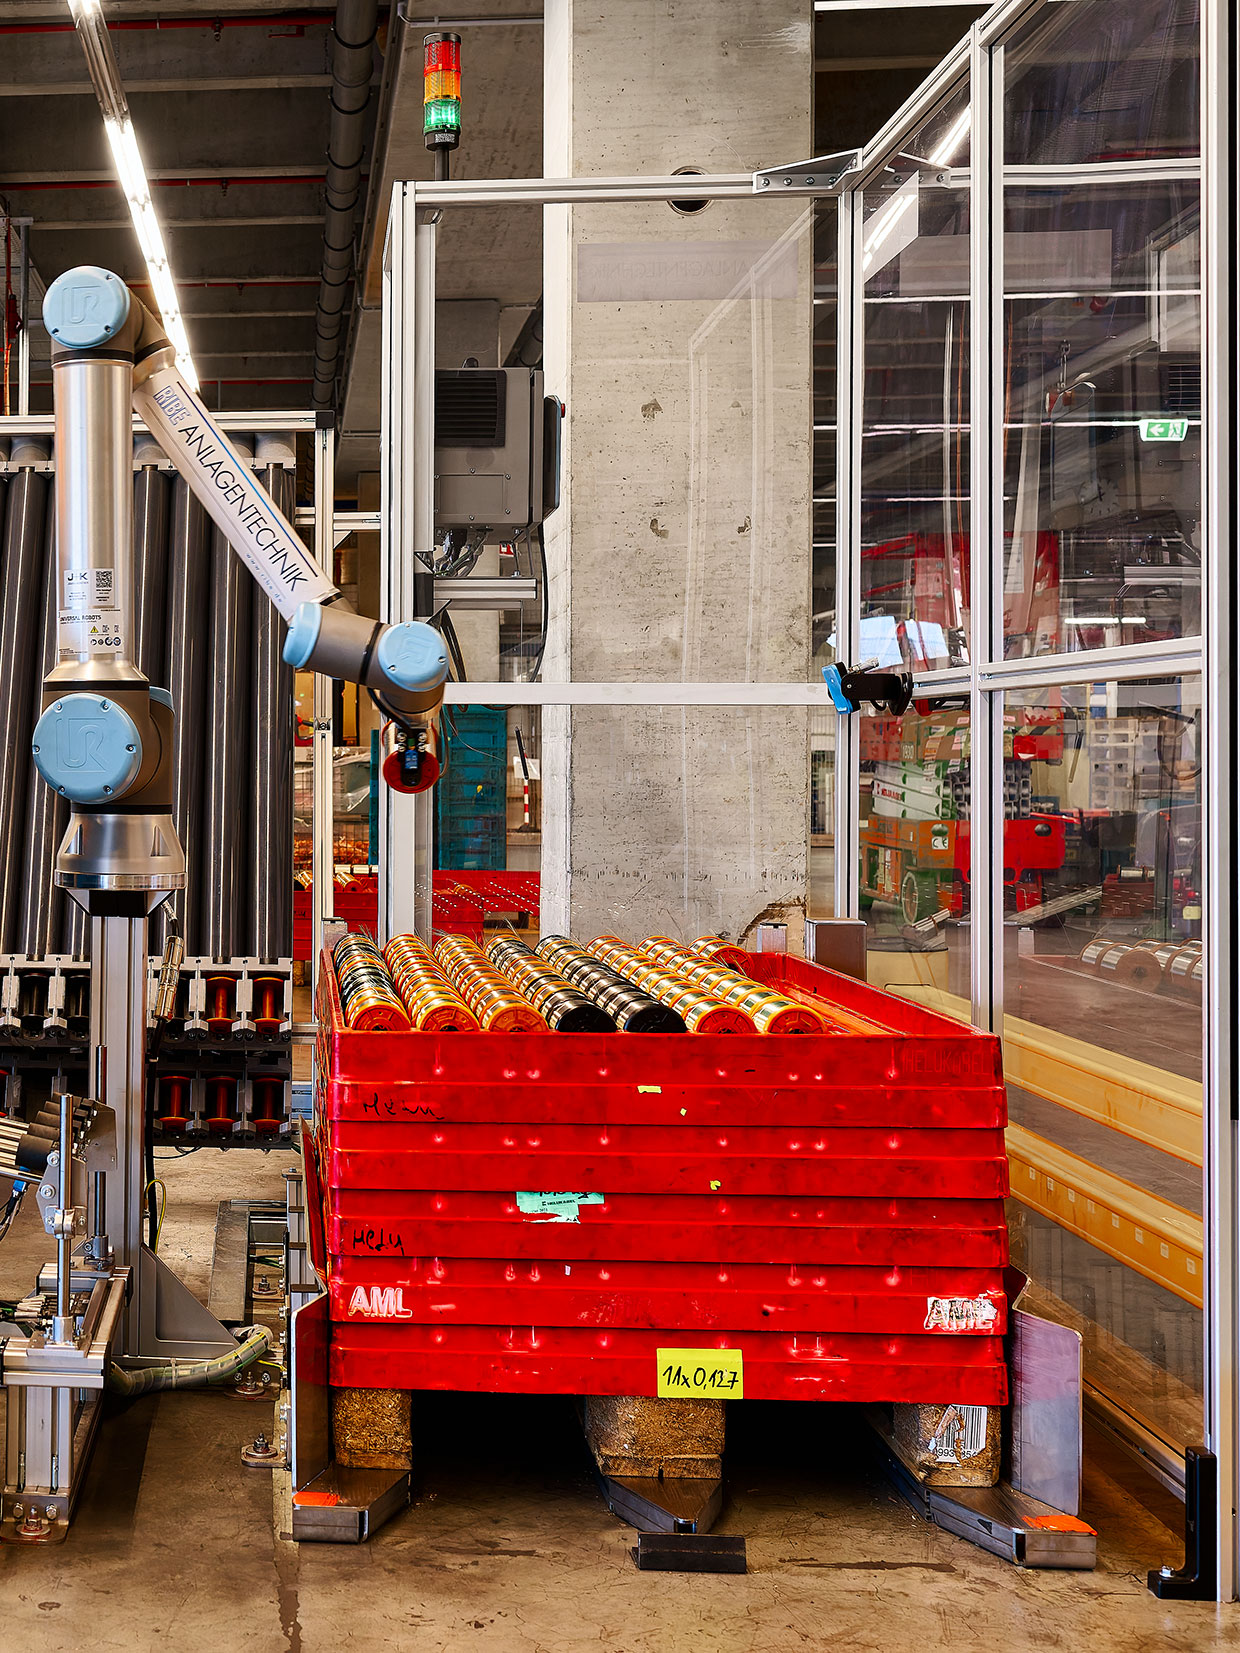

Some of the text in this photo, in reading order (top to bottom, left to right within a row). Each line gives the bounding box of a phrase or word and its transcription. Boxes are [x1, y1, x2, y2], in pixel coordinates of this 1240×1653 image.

[152, 385, 308, 592] RIBE ANLAGENTECHNIK
[348, 1285, 413, 1318] AML
